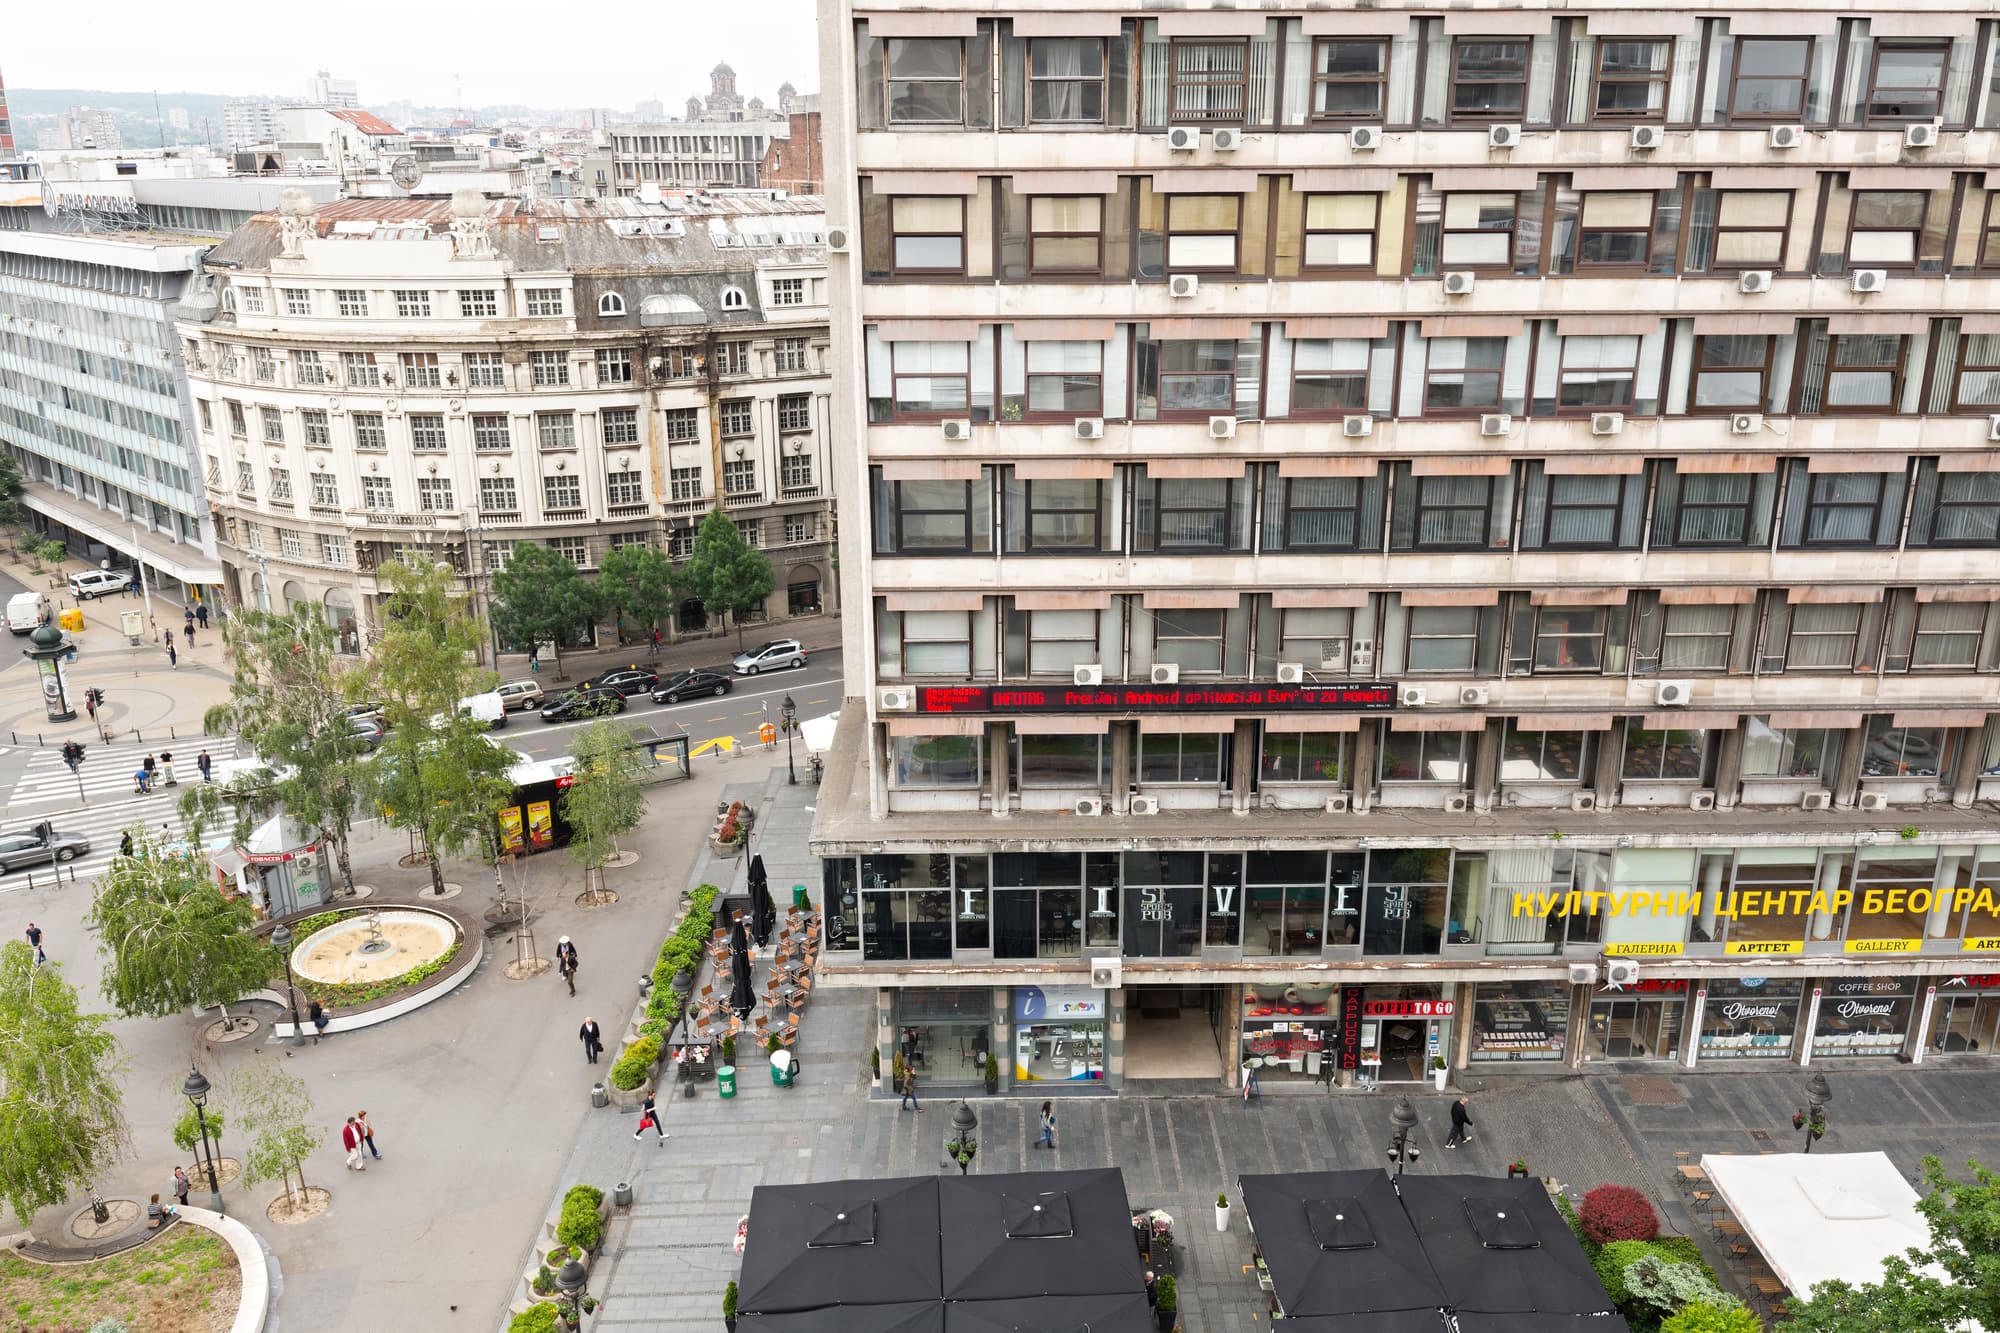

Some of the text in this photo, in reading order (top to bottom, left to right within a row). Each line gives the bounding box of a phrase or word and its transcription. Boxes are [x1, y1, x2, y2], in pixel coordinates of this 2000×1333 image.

[1125, 690, 1179, 705] Android
[1185, 690, 1262, 705] aplikaciju
[1383, 900, 1412, 909] SPORS
[1512, 890, 1702, 918] КУЛТУРНИ
[1713, 890, 1853, 921] ЦЕНТАР
[1142, 910, 1172, 920] PUB
[1616, 943, 1677, 955] ГАЛЕРИЈА
[1737, 943, 1790, 953] АРТГЕТ
[1855, 941, 1909, 952] GALLERY
[1838, 982, 1901, 992] COFFEE SHOP
[1415, 1002, 1431, 1014] TO
[1435, 1002, 1453, 1014] GO
[1343, 989, 1359, 1069] CAPPUCCINO
